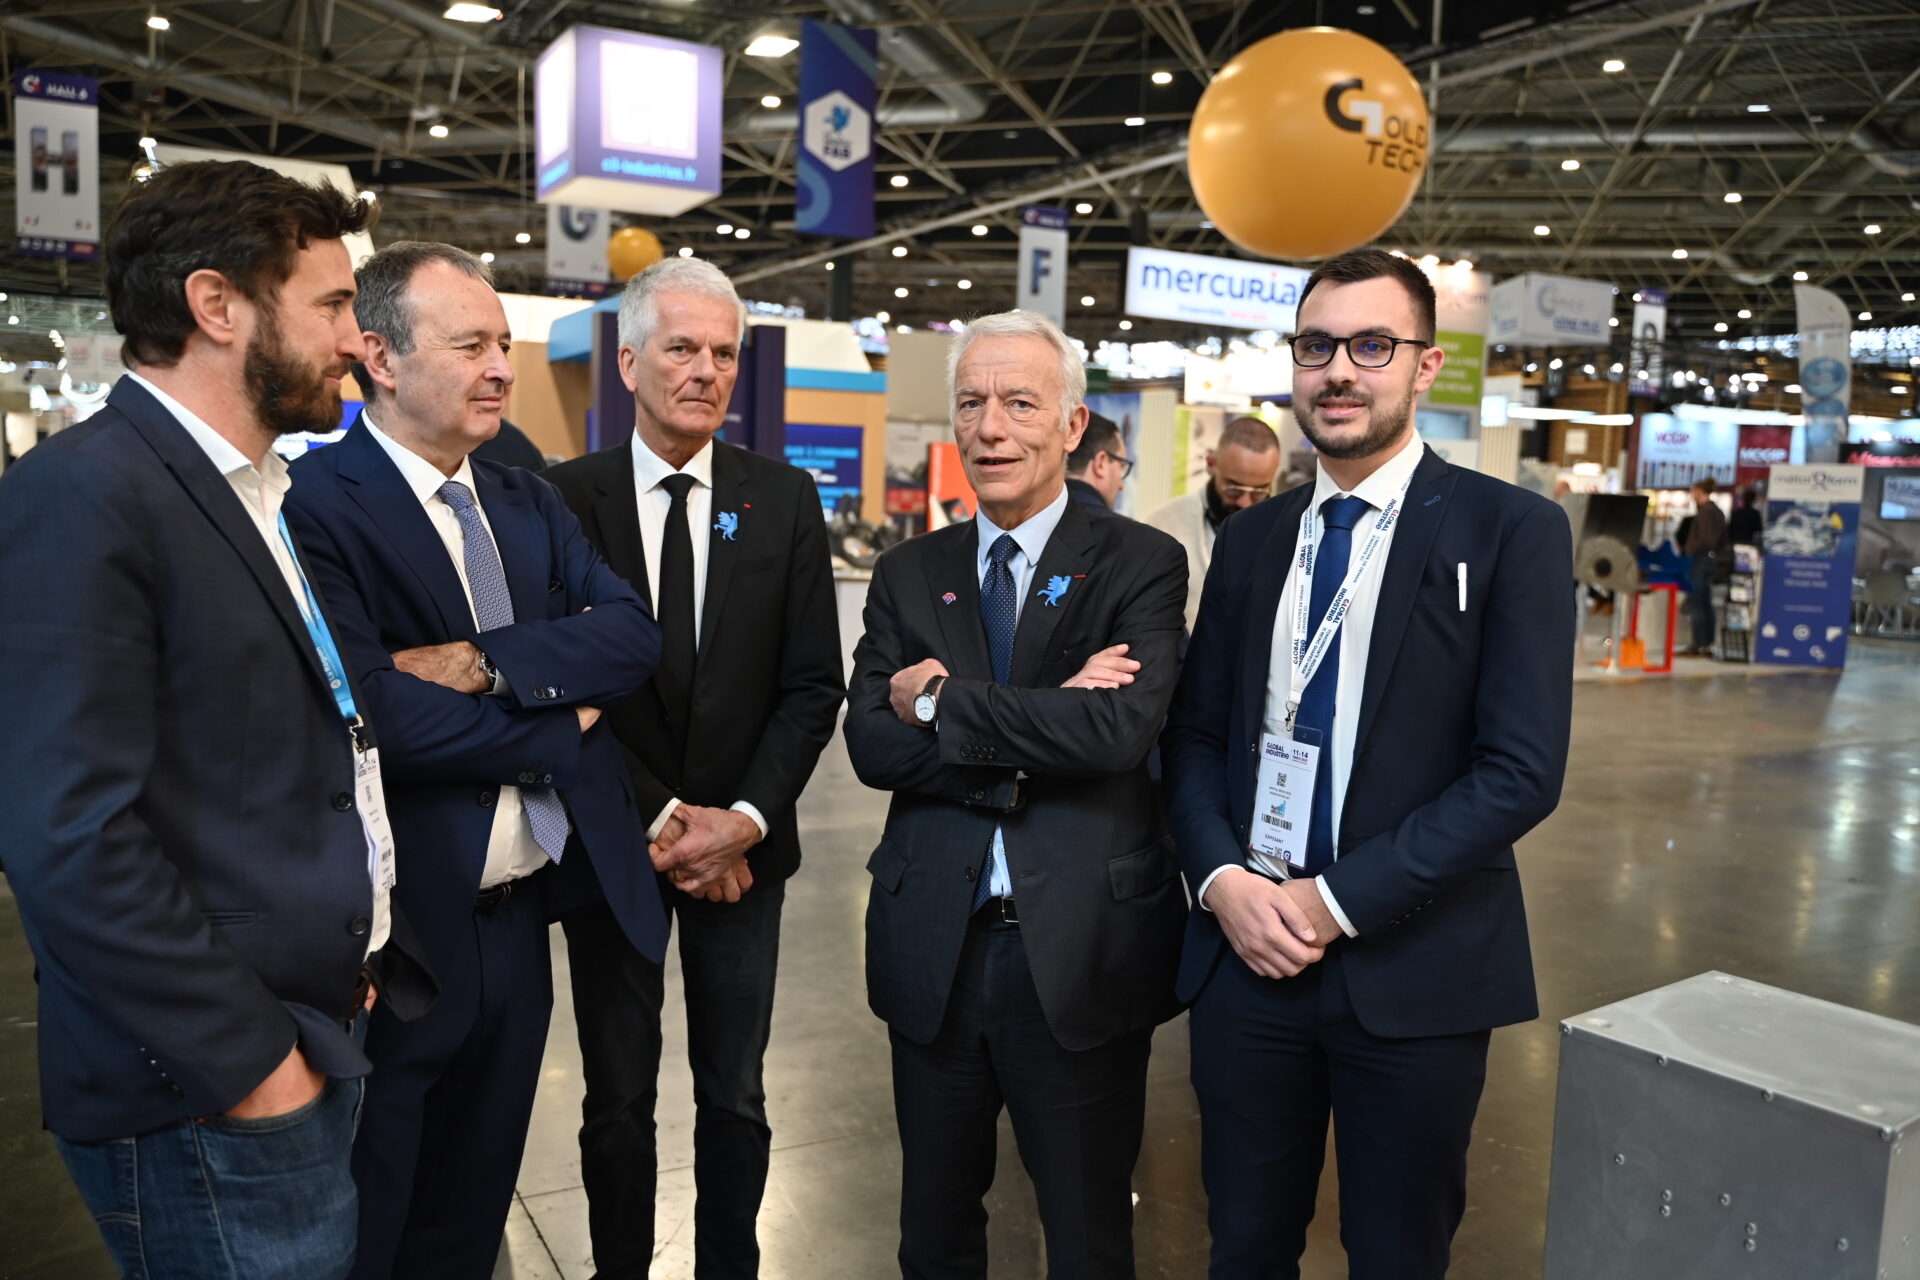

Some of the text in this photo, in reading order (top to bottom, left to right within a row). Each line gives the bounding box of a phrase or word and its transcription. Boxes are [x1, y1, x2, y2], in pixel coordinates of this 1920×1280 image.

[30, 127, 79, 196] H
[1031, 247, 1051, 295] F
[1332, 598, 1350, 624] GLOBAL
[1266, 742, 1284, 753] GLOBAL
